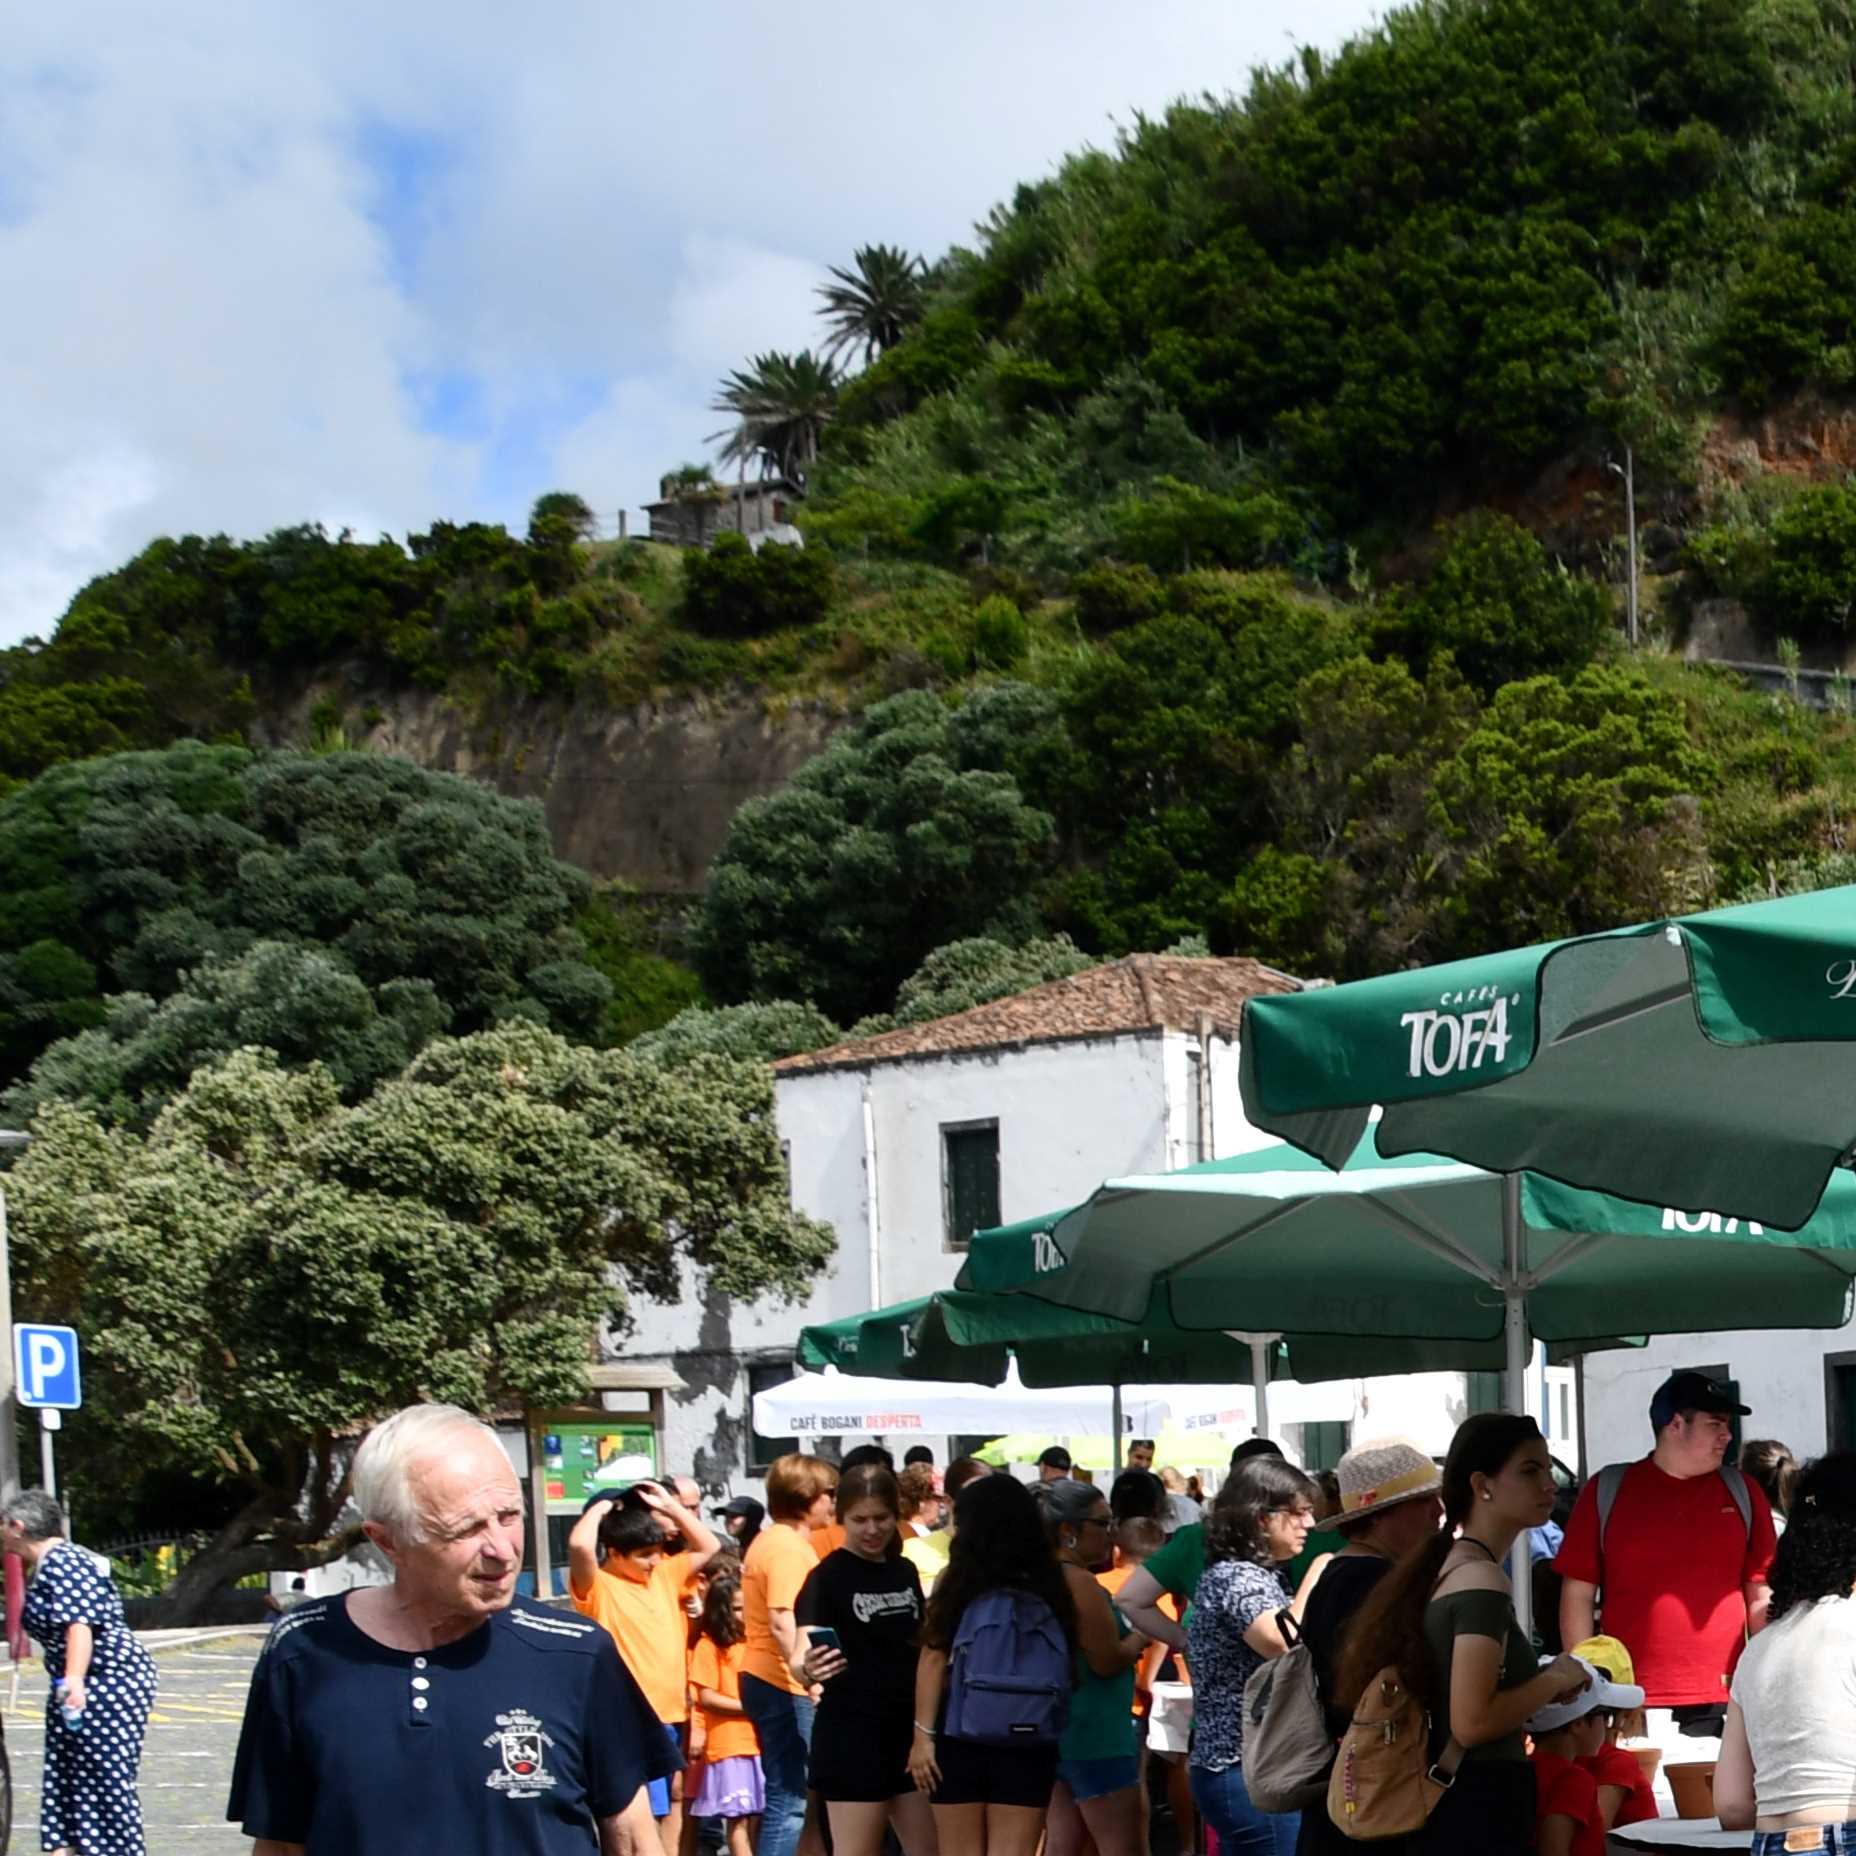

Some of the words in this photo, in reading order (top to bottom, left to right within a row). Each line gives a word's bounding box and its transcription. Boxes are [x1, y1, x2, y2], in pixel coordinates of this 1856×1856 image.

[1400, 997, 1513, 1077] TOFA
[29, 1333, 66, 1399] P
[790, 1413, 817, 1430] CAFÉ
[821, 1415, 863, 1429] BOGANI
[866, 1414, 923, 1428] DESPERTA
